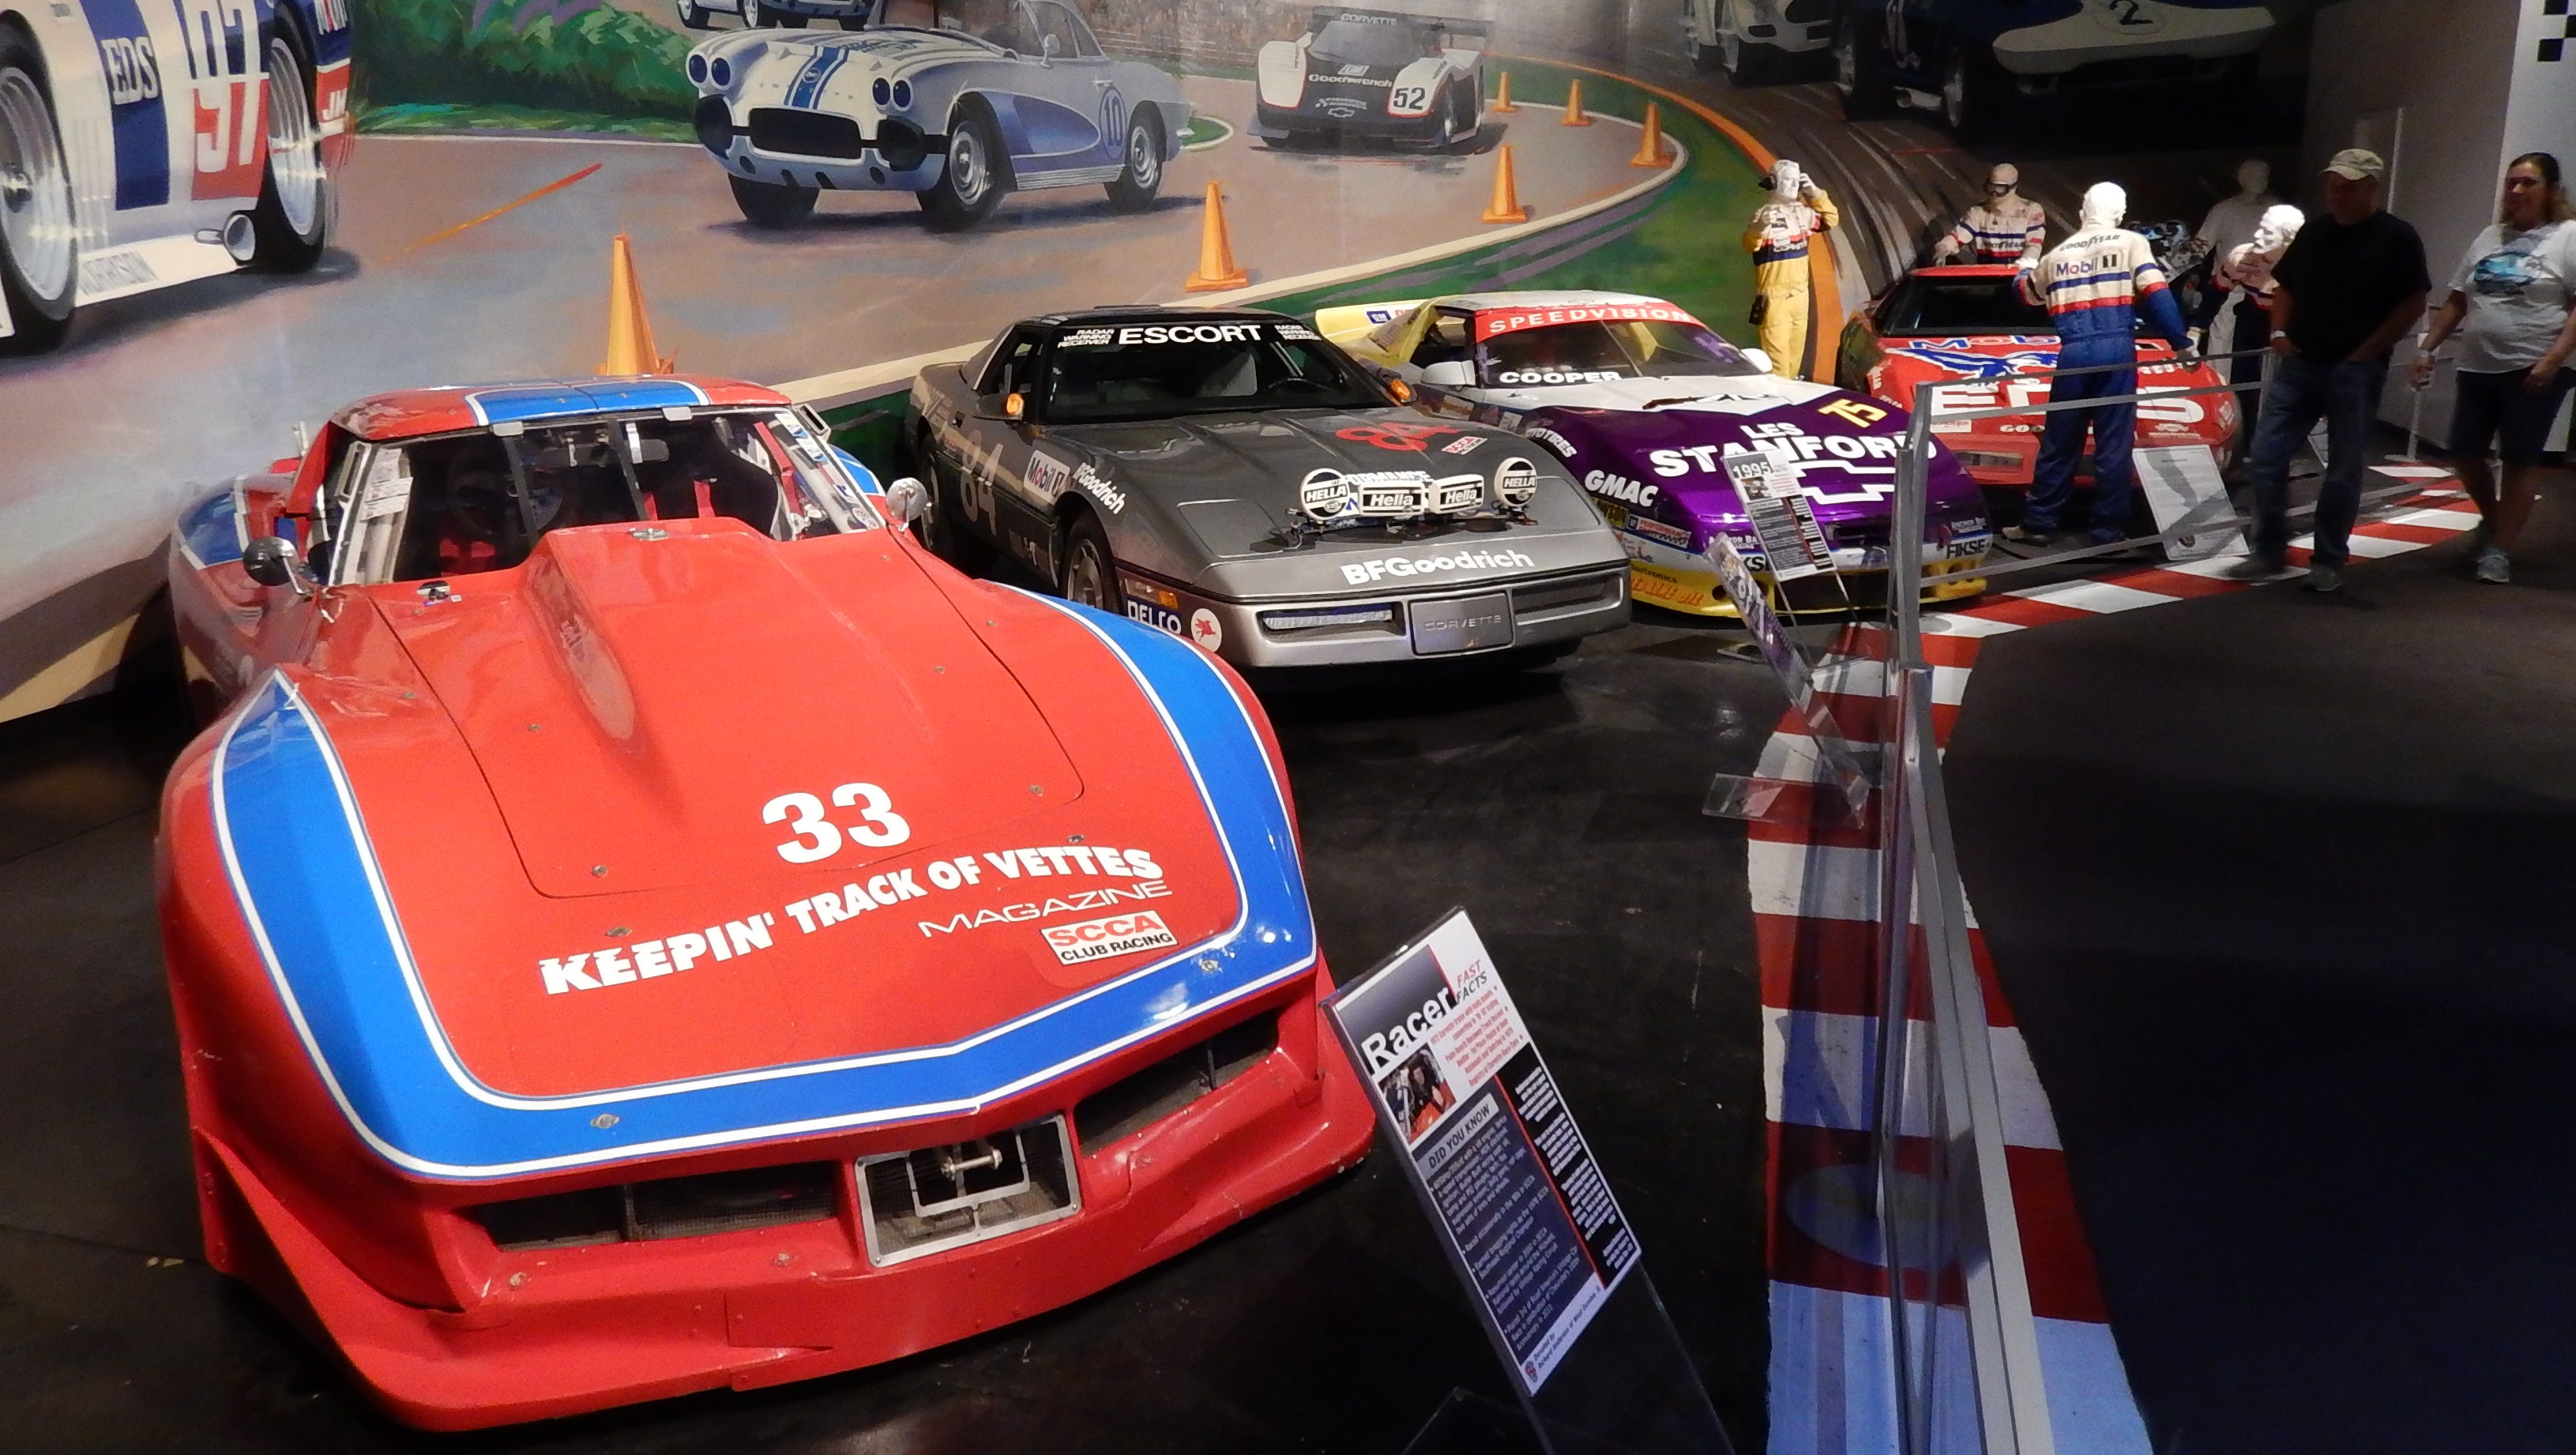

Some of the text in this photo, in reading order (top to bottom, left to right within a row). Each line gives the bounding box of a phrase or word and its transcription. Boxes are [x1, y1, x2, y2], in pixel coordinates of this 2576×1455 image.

[1341, 13, 1397, 26] CORVETTE
[101, 36, 158, 105] EDS
[1393, 87, 1426, 110] 52
[1104, 96, 1123, 147] 10
[2056, 257, 2099, 276] Mobil
[1488, 307, 1692, 333] SPEEDVISION
[1119, 325, 1261, 345] ESCORT
[1908, 335, 2062, 349] Mob
[1499, 371, 1622, 385] COOPER
[1818, 398, 1888, 428] 75
[1543, 430, 1578, 458] TIRES
[1740, 422, 1805, 439] LES
[1027, 456, 1055, 494] Mobil
[1504, 476, 1536, 487] HELLA
[1732, 461, 1771, 479] 1995
[1073, 461, 1126, 515] BFGoodrich
[1306, 485, 1347, 503] HELLA
[1370, 493, 1414, 506] Hella
[1445, 487, 1477, 504] Hella
[1585, 469, 1659, 508] GMAC
[1946, 539, 1986, 558] FIKSE
[1340, 551, 1534, 585] BFGoodrich
[1424, 615, 1502, 631] CORVETTE
[762, 782, 911, 864] 33
[538, 846, 1164, 995] KEEPIN' TRACK OF VETTES
[917, 880, 1173, 938] MAGAZINE
[1048, 915, 1164, 947] SCCA
[1061, 933, 1174, 962] CLUB RACING
[1457, 959, 1481, 987] FAST
[1456, 971, 1488, 1005] FACTS
[1361, 987, 1450, 1075] Racer
[1427, 1103, 1492, 1169] DID YOU KNOW
